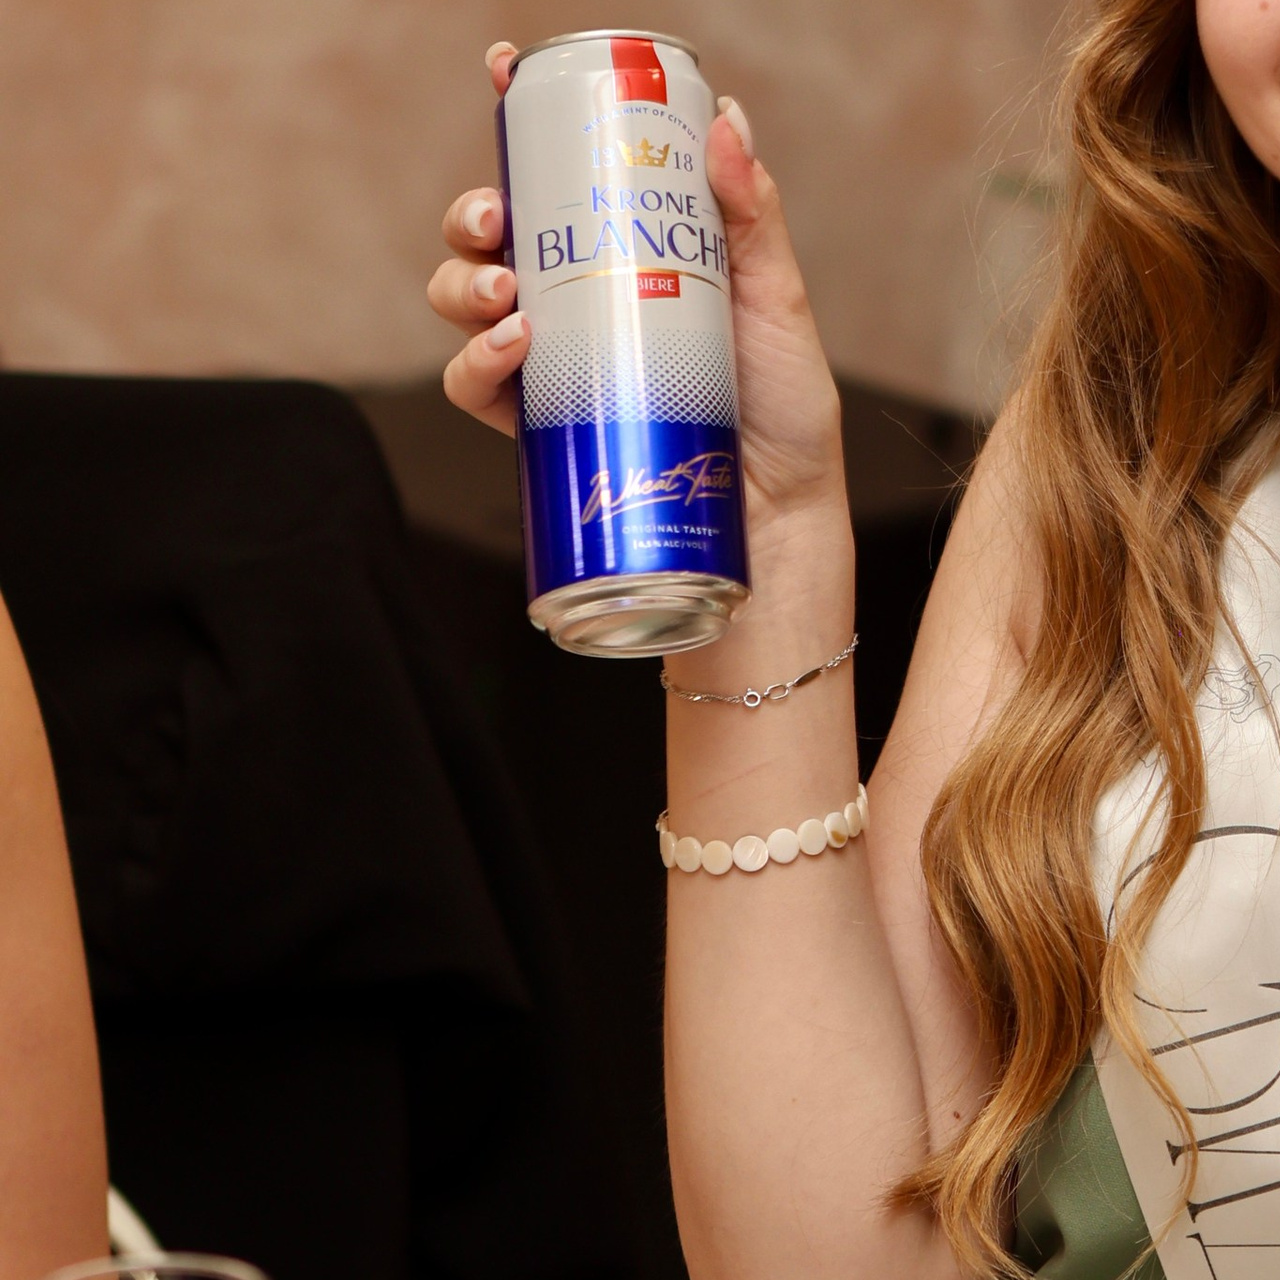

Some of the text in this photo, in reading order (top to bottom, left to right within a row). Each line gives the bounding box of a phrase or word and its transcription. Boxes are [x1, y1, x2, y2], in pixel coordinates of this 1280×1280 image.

[623, 106, 648, 116] HINT
[652, 109, 665, 117] OF
[674, 151, 693, 172] 18
[591, 184, 699, 219] KRONE
[537, 218, 729, 280] BLANCHE
[682, 452, 733, 506] Taste
[622, 524, 680, 534] ORIGINAL
